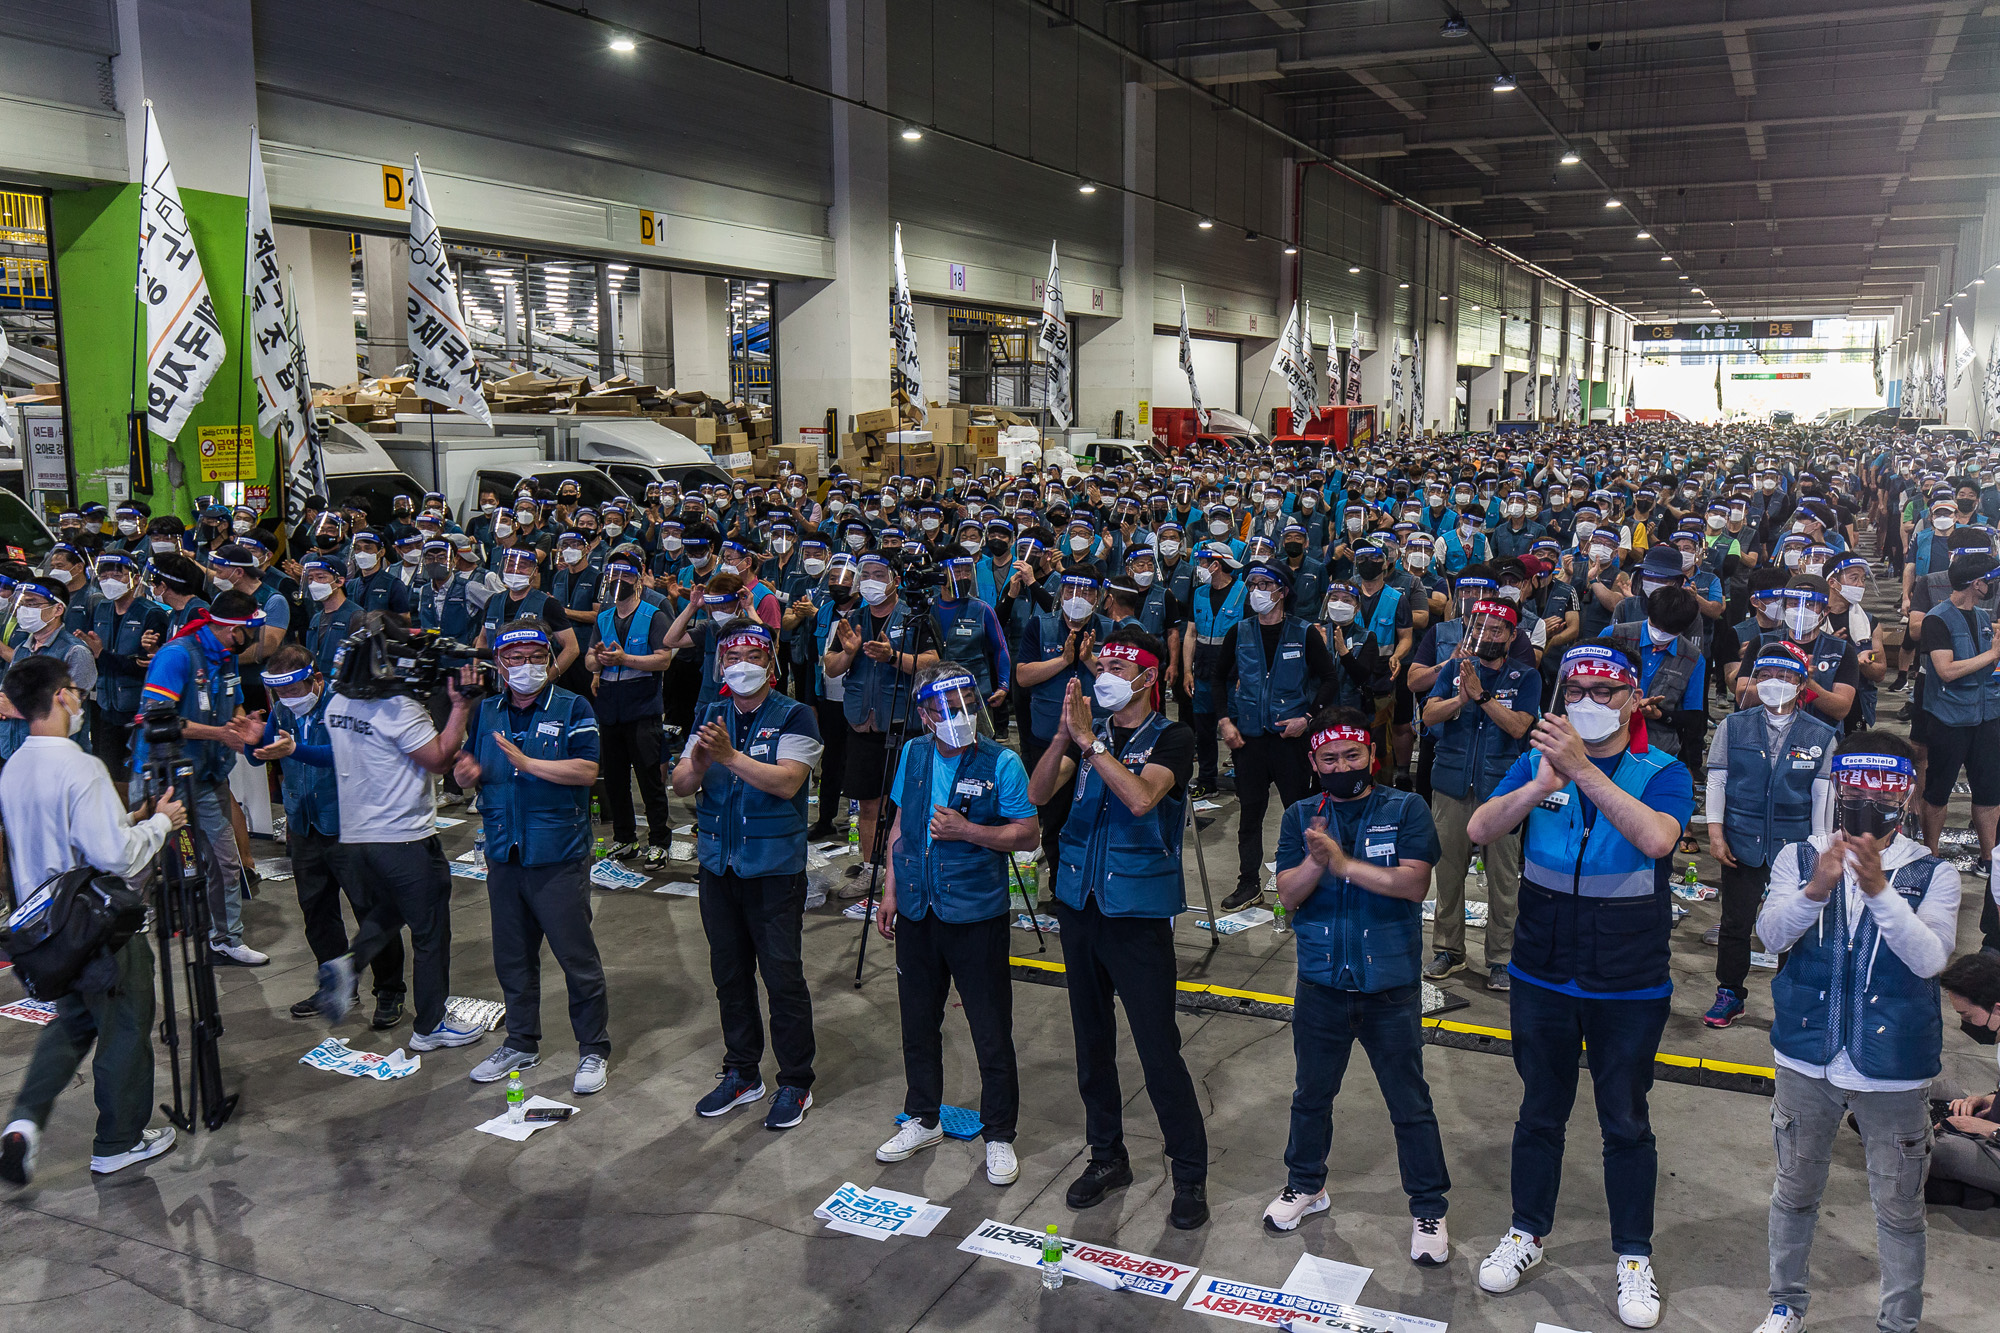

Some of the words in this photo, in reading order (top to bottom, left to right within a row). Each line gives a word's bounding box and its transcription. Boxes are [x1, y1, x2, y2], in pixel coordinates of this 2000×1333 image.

[953, 271, 963, 287] 18
[1035, 284, 1043, 298] 19
[1652, 326, 1675, 339] C동
[1714, 324, 1741, 337] 출구
[1768, 323, 1794, 337] B동
[33, 426, 54, 438] 여드름
[217, 438, 254, 451] 금연구역
[247, 489, 267, 497] 소화기
[1490, 603, 1508, 617] 투쟁
[504, 632, 517, 640] Face
[1111, 645, 1139, 661] 투쟁
[1584, 647, 1609, 655] Shield
[1590, 660, 1621, 680] 투쟁
[1776, 659, 1794, 667] Shield
[935, 681, 950, 690] Face
[950, 677, 969, 686] Shield
[1310, 730, 1326, 751] 단결
[1340, 725, 1365, 742] 투쟁
[1866, 757, 1894, 766] Shield
[1883, 773, 1909, 791] 투쟁
[834, 1186, 918, 1220] 우정본부
[1072, 1244, 1190, 1282] 사회적합의
[1214, 1281, 1278, 1304] 단체협약
